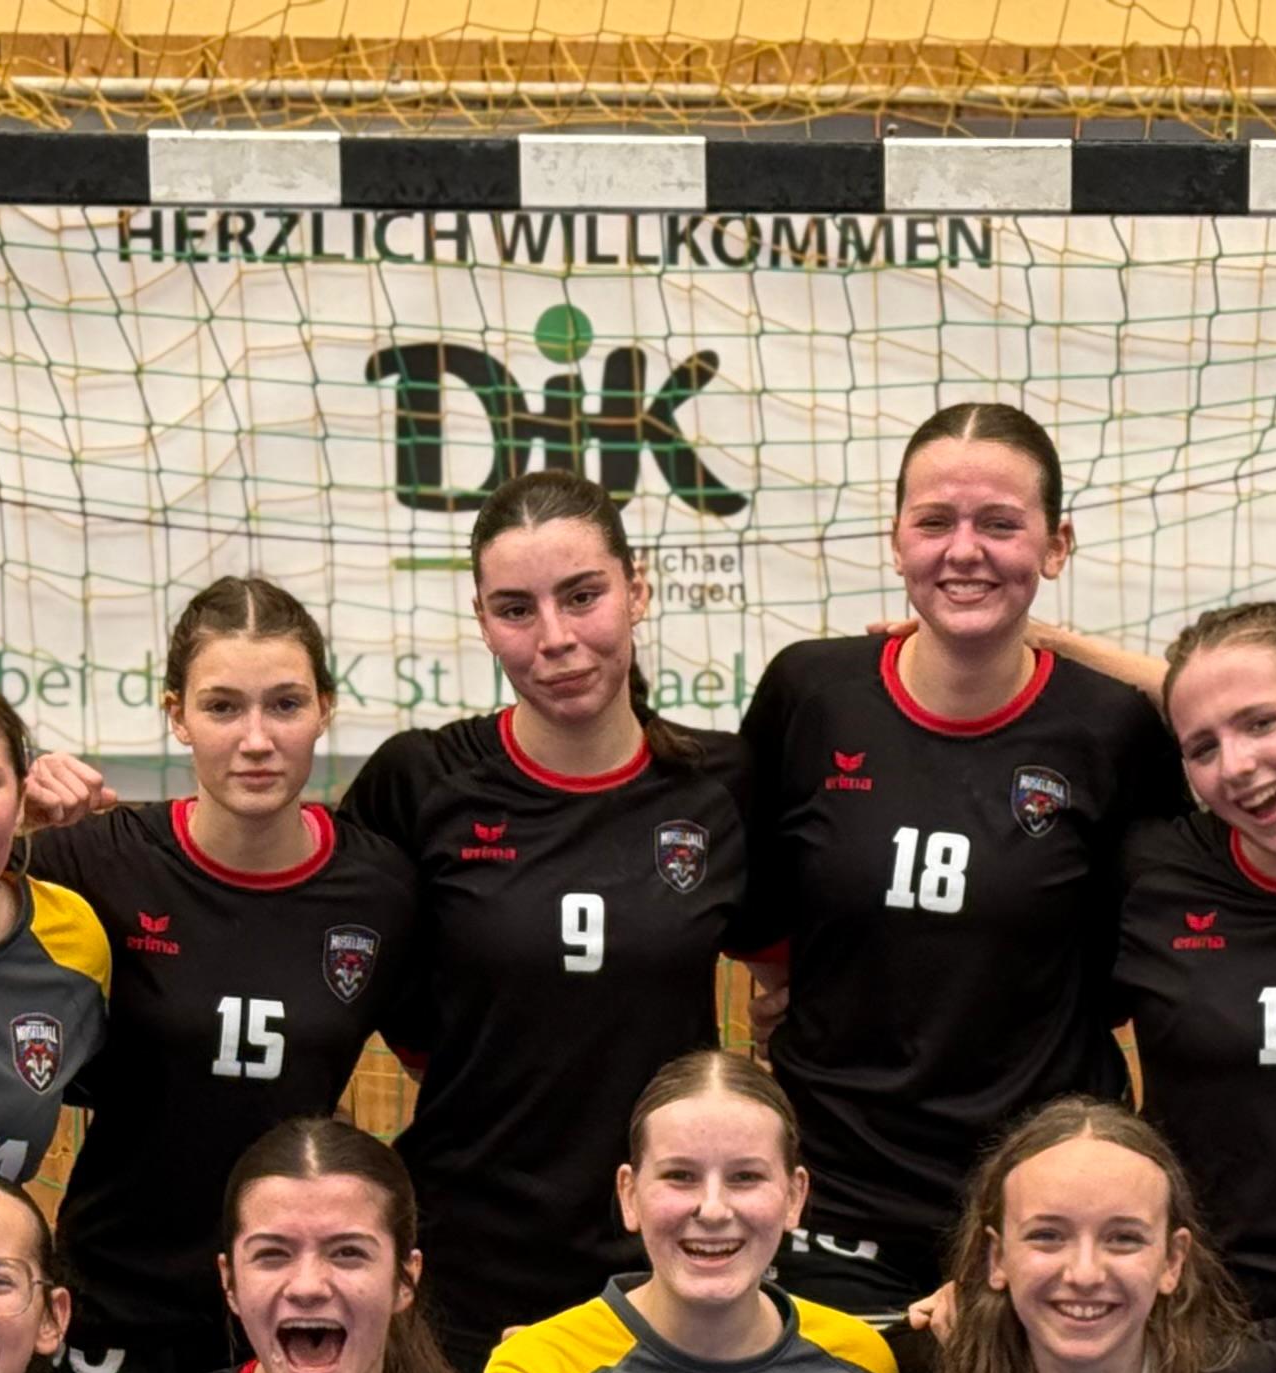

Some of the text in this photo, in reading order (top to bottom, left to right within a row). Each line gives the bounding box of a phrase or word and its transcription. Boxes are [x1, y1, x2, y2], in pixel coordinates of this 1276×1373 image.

[118, 210, 994, 269] HERZLICH WILLKOMMEN
[636, 548, 743, 573] ichael
[885, 826, 971, 914] 18
[561, 893, 605, 972] 9
[211, 996, 286, 1079] 15
